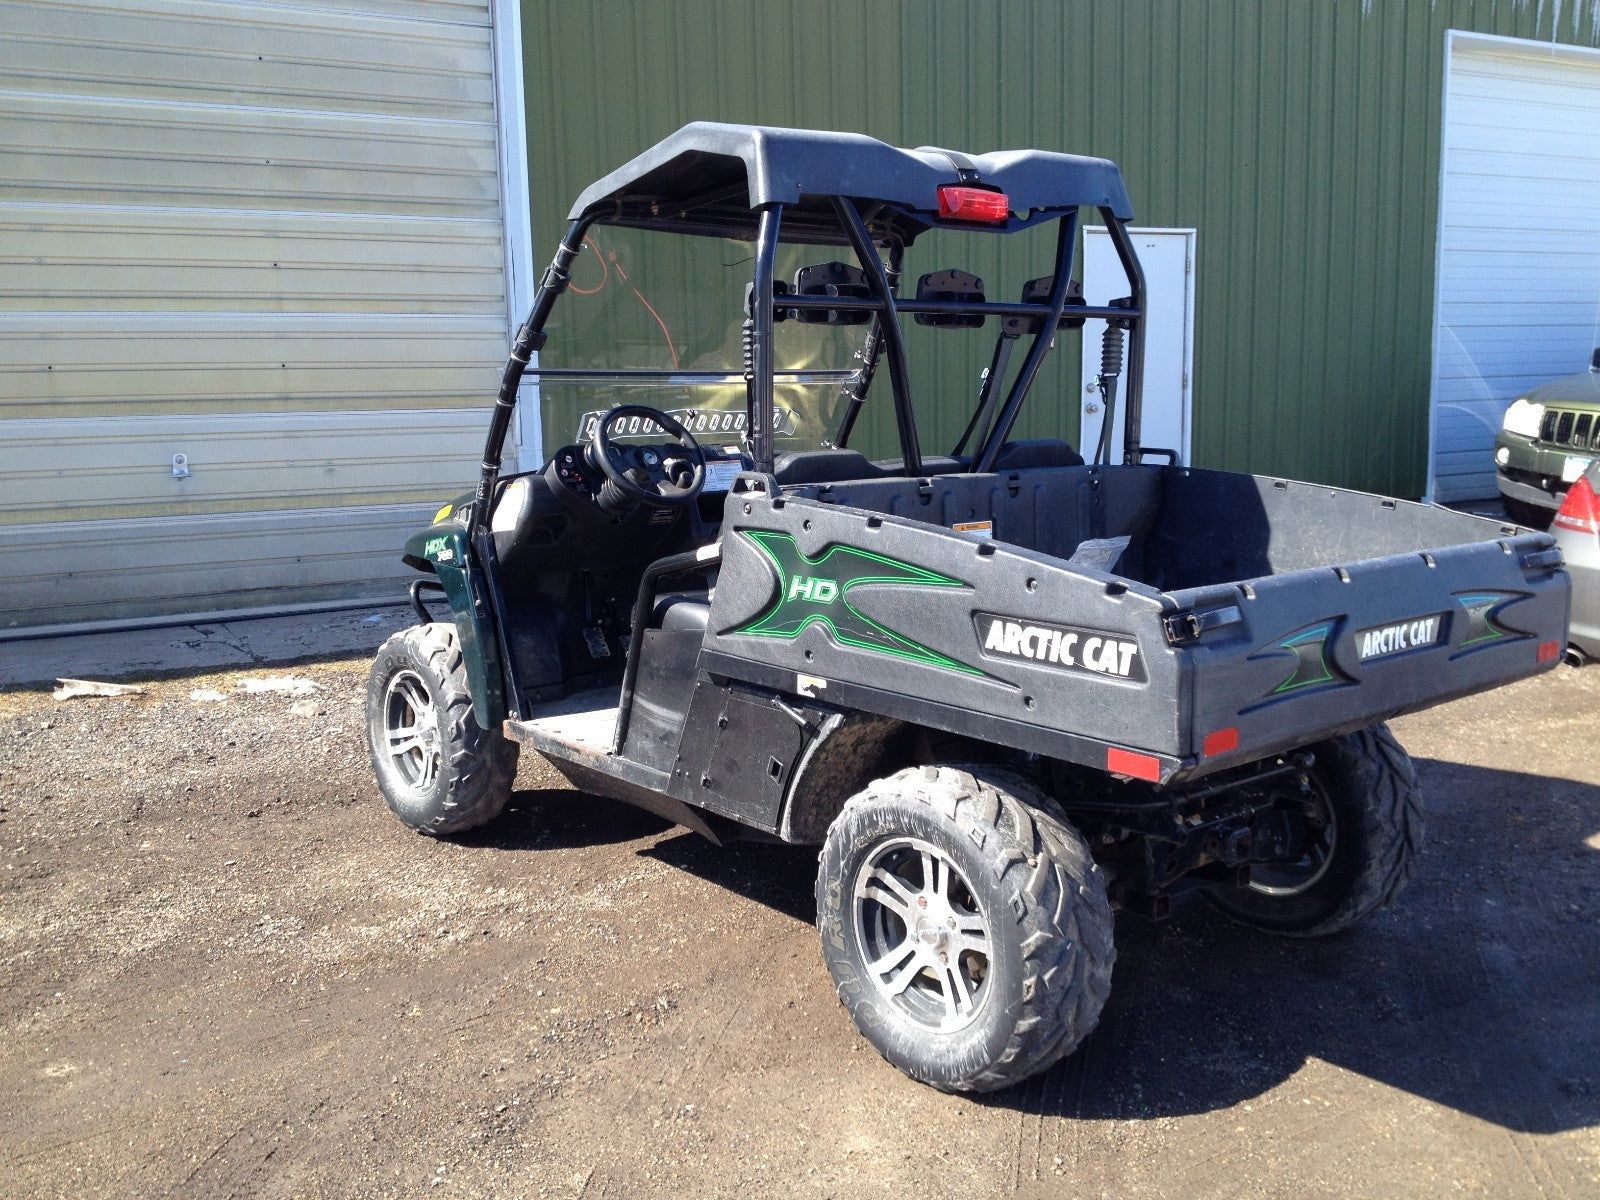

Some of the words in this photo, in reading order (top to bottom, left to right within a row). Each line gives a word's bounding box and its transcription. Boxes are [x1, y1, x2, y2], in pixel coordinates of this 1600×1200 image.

[424, 536, 449, 559] HDX
[787, 575, 840, 605] HD
[985, 620, 1079, 666] ARCTIC
[1082, 637, 1138, 676] CAT
[1361, 623, 1408, 658] ARCTIC
[1410, 618, 1434, 646] CAT
[826, 876, 883, 1029] DURO
